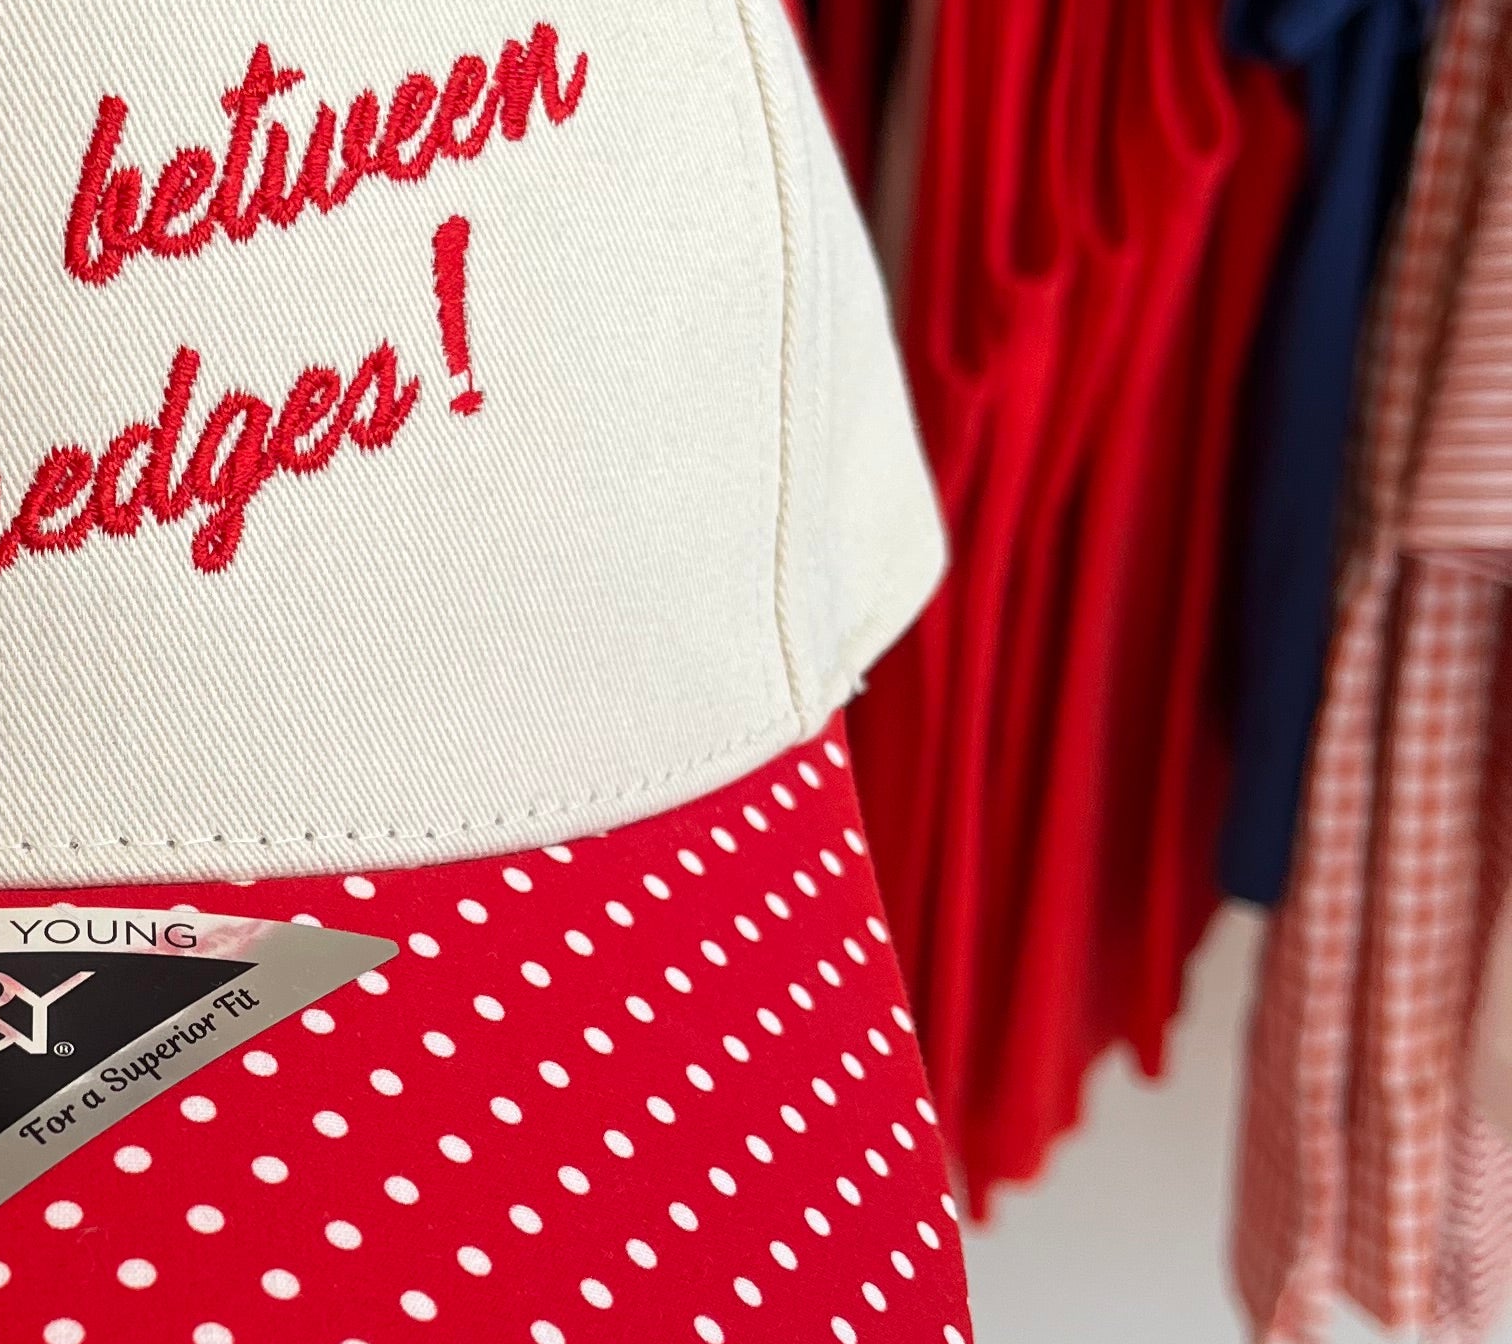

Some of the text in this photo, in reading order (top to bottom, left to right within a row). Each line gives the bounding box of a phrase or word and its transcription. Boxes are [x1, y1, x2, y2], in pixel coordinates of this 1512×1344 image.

[65, 23, 588, 287] between
[9, 918, 197, 949] YOUNG
[19, 988, 260, 1145] For a Superior Fit
